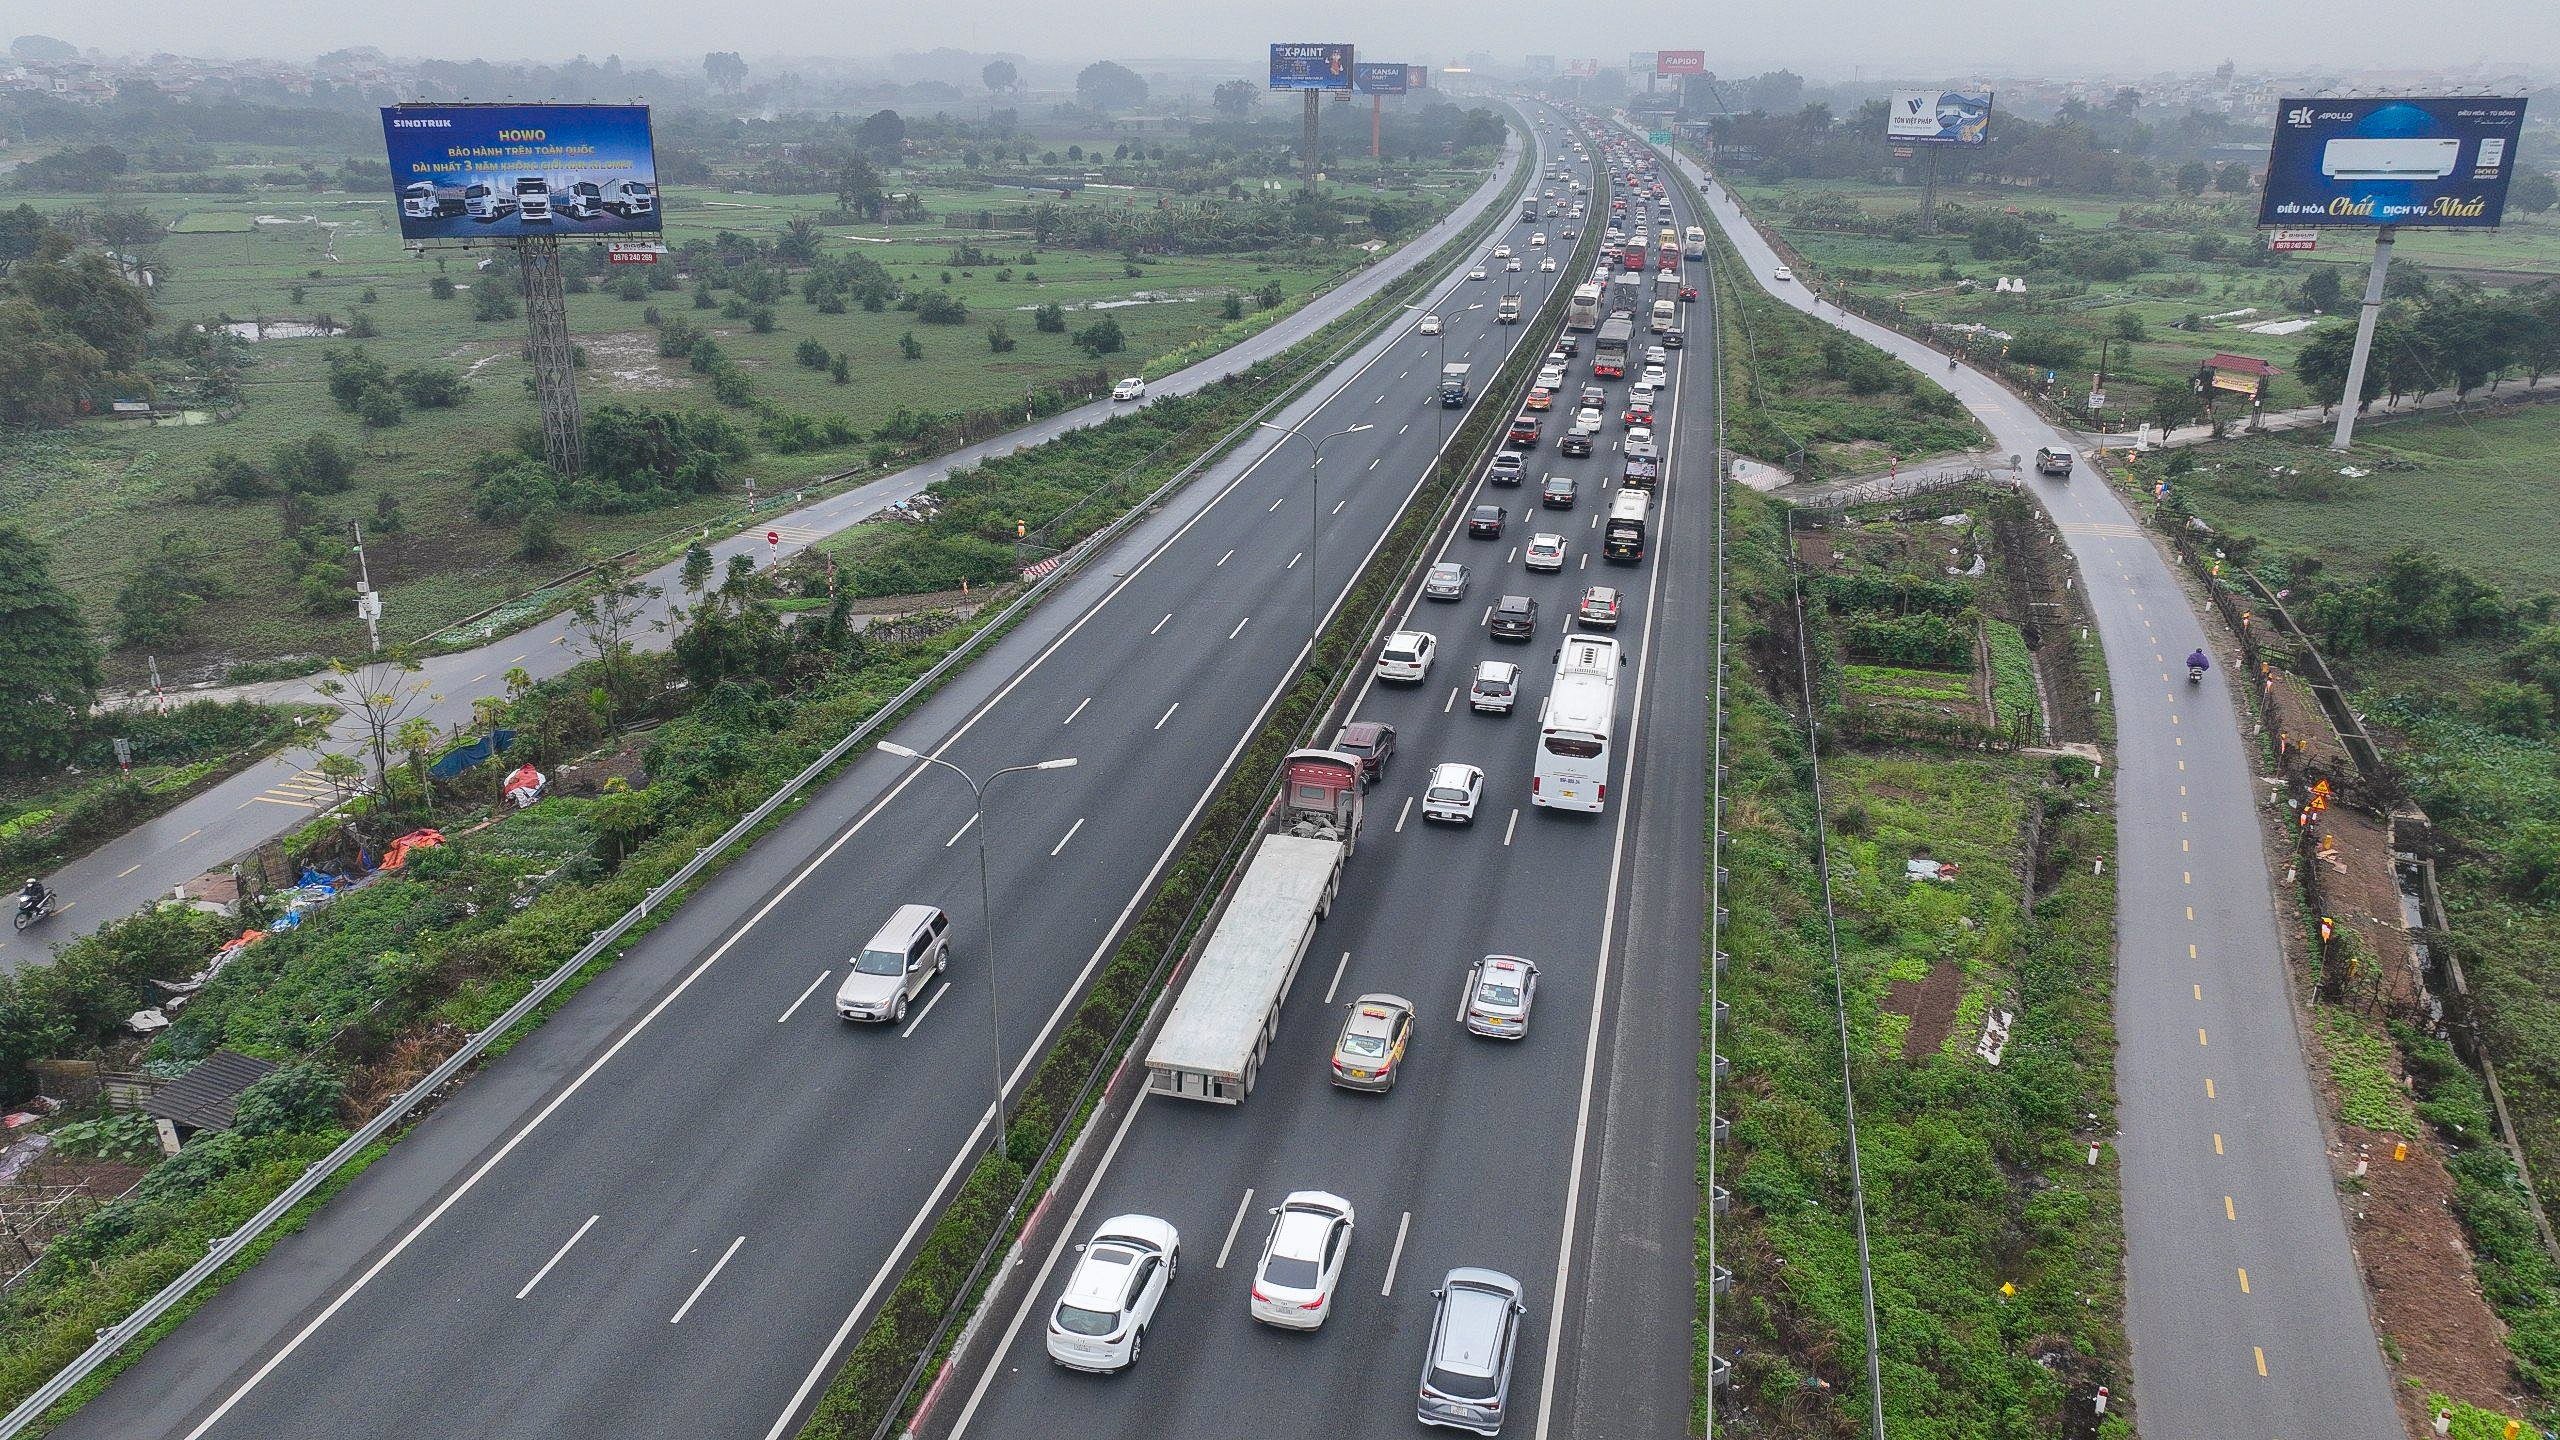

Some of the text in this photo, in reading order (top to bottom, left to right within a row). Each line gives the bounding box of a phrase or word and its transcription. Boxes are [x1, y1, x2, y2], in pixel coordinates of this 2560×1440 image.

[1284, 47, 1324, 57] X-PAINT
[1665, 56, 1698, 65] RAPIDO
[1371, 68, 1399, 76] KANSAI
[2317, 112, 2354, 120] APOLLO
[393, 119, 452, 128] SINOTRUK
[499, 129, 546, 142] HOWO
[473, 144, 503, 156] HÀNH
[504, 144, 533, 156] TRÊN
[535, 143, 563, 155] TOÀN
[412, 160, 431, 173] DÀI
[433, 159, 463, 173] NHẤT
[464, 159, 473, 172] 3
[2276, 194, 2486, 217] ĐIỀU HÒA Chất DỊCH VỤ Nhất
[629, 253, 641, 261] 240
